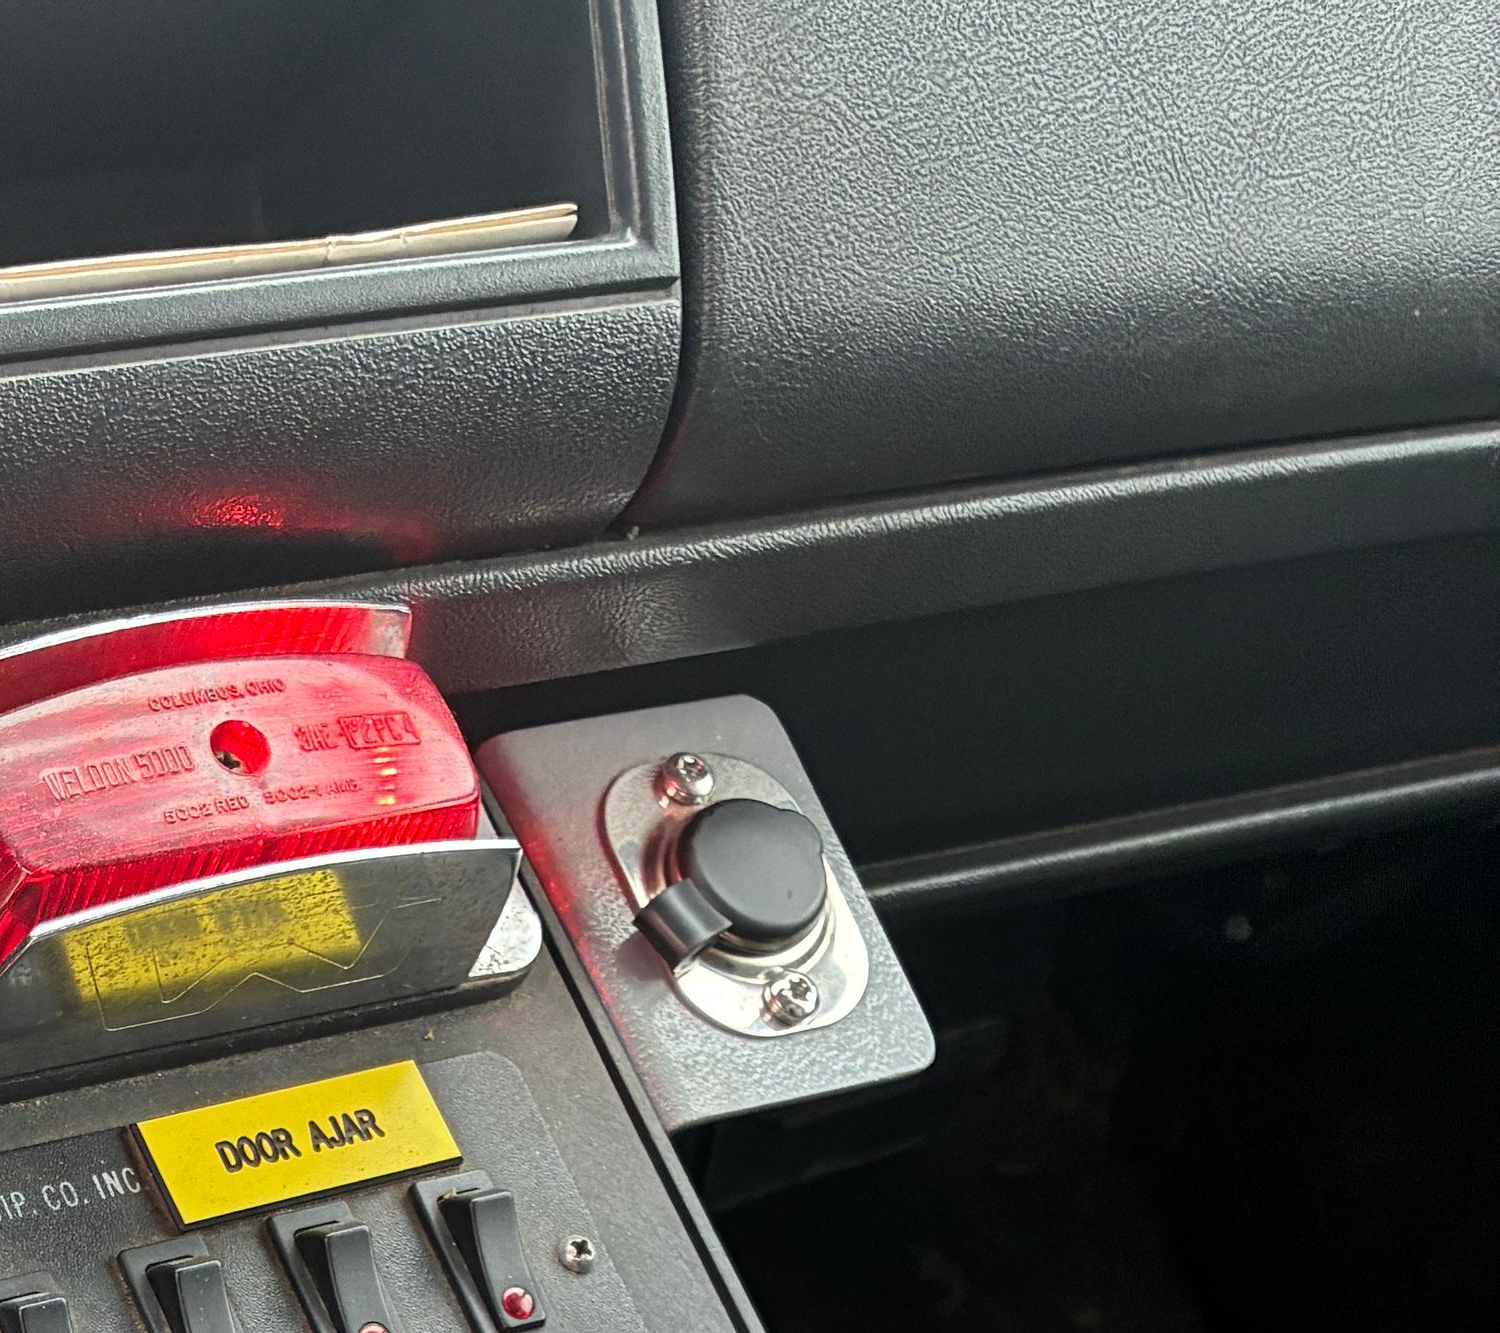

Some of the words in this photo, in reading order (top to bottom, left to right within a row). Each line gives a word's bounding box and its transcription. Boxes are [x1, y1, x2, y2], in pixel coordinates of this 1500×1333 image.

[245, 678, 286, 697] OHIO
[41, 755, 135, 801] WELDON
[134, 745, 196, 782] 5000
[164, 803, 213, 824] 5002
[216, 796, 250, 814] RED
[214, 1123, 299, 1176] DOOR
[308, 1107, 386, 1155] AJAR
[41, 1181, 90, 1212] CO.
